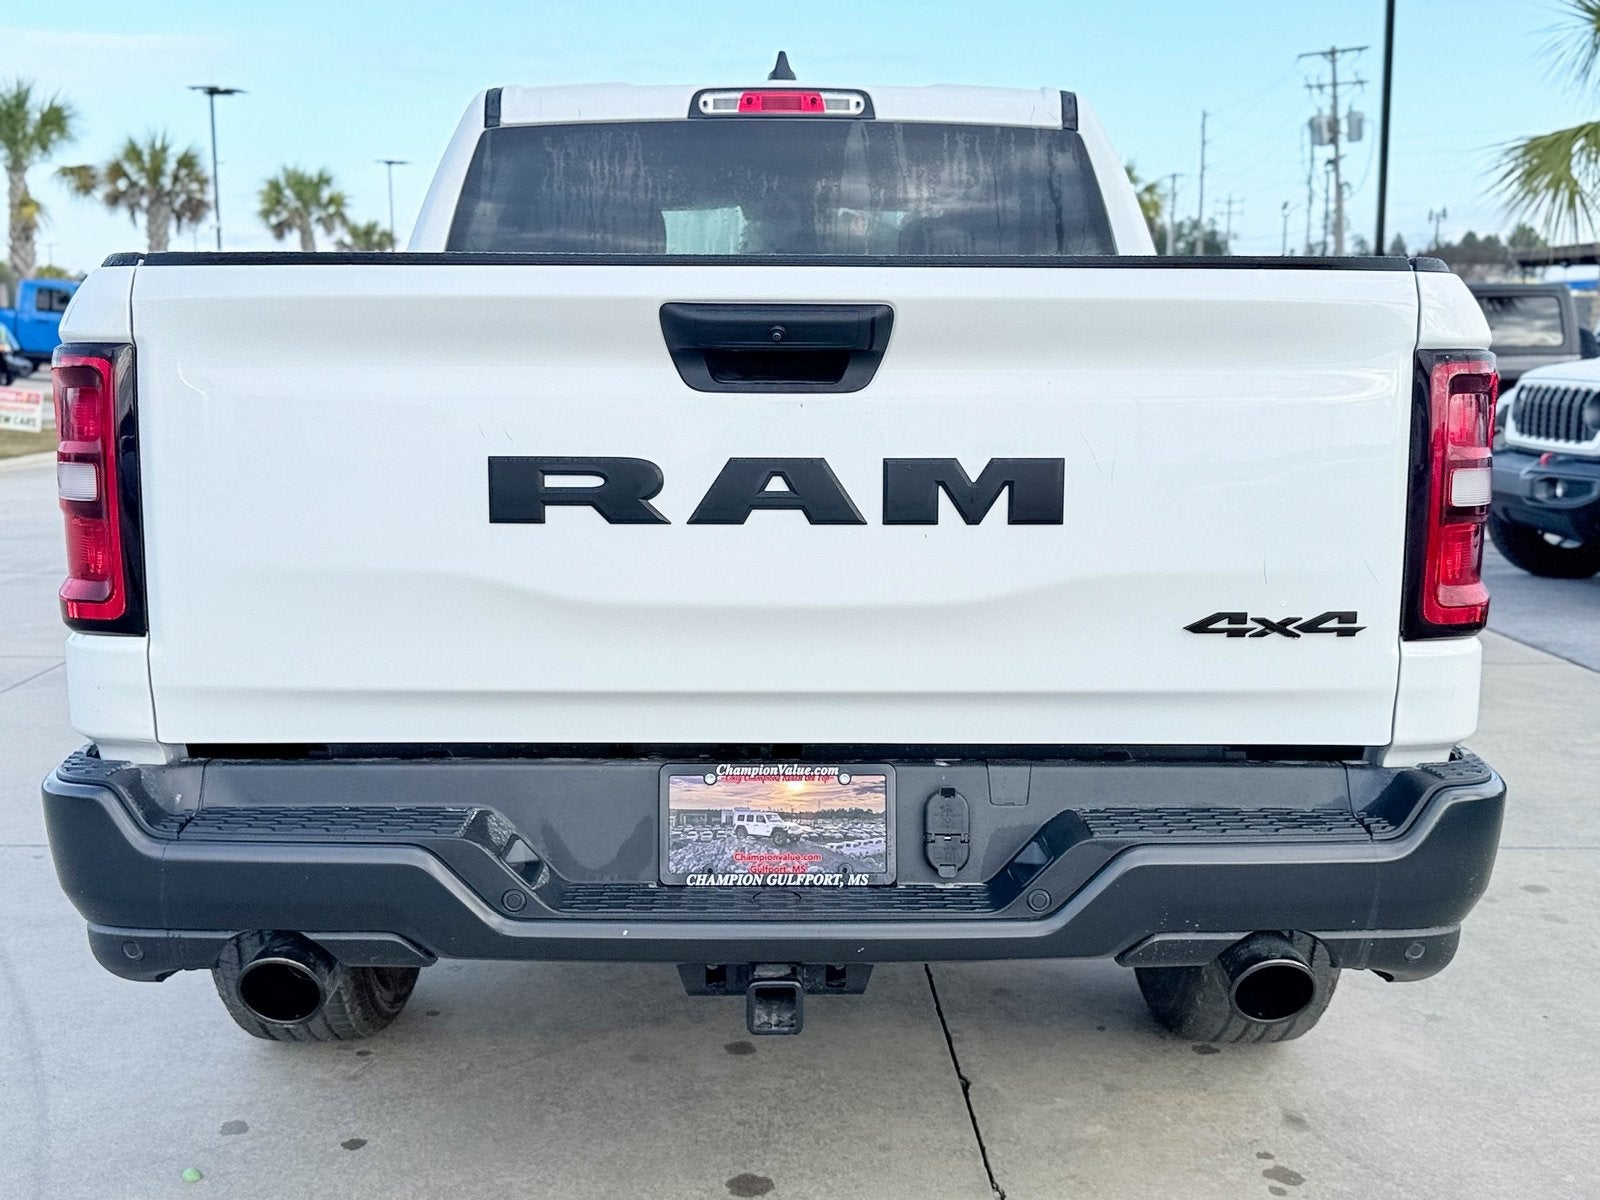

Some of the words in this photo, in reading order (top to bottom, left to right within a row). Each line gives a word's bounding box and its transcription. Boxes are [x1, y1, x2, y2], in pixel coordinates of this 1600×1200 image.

[488, 455, 1065, 526] RAM
[1183, 611, 1368, 638] 4x4
[716, 764, 839, 778] ChampionValue.com
[734, 853, 821, 863] Championvalue.com
[792, 865, 806, 874] MS
[686, 873, 763, 886] CHAMPION
[766, 873, 844, 888] GULFPORT,
[847, 873, 869, 886] MS
